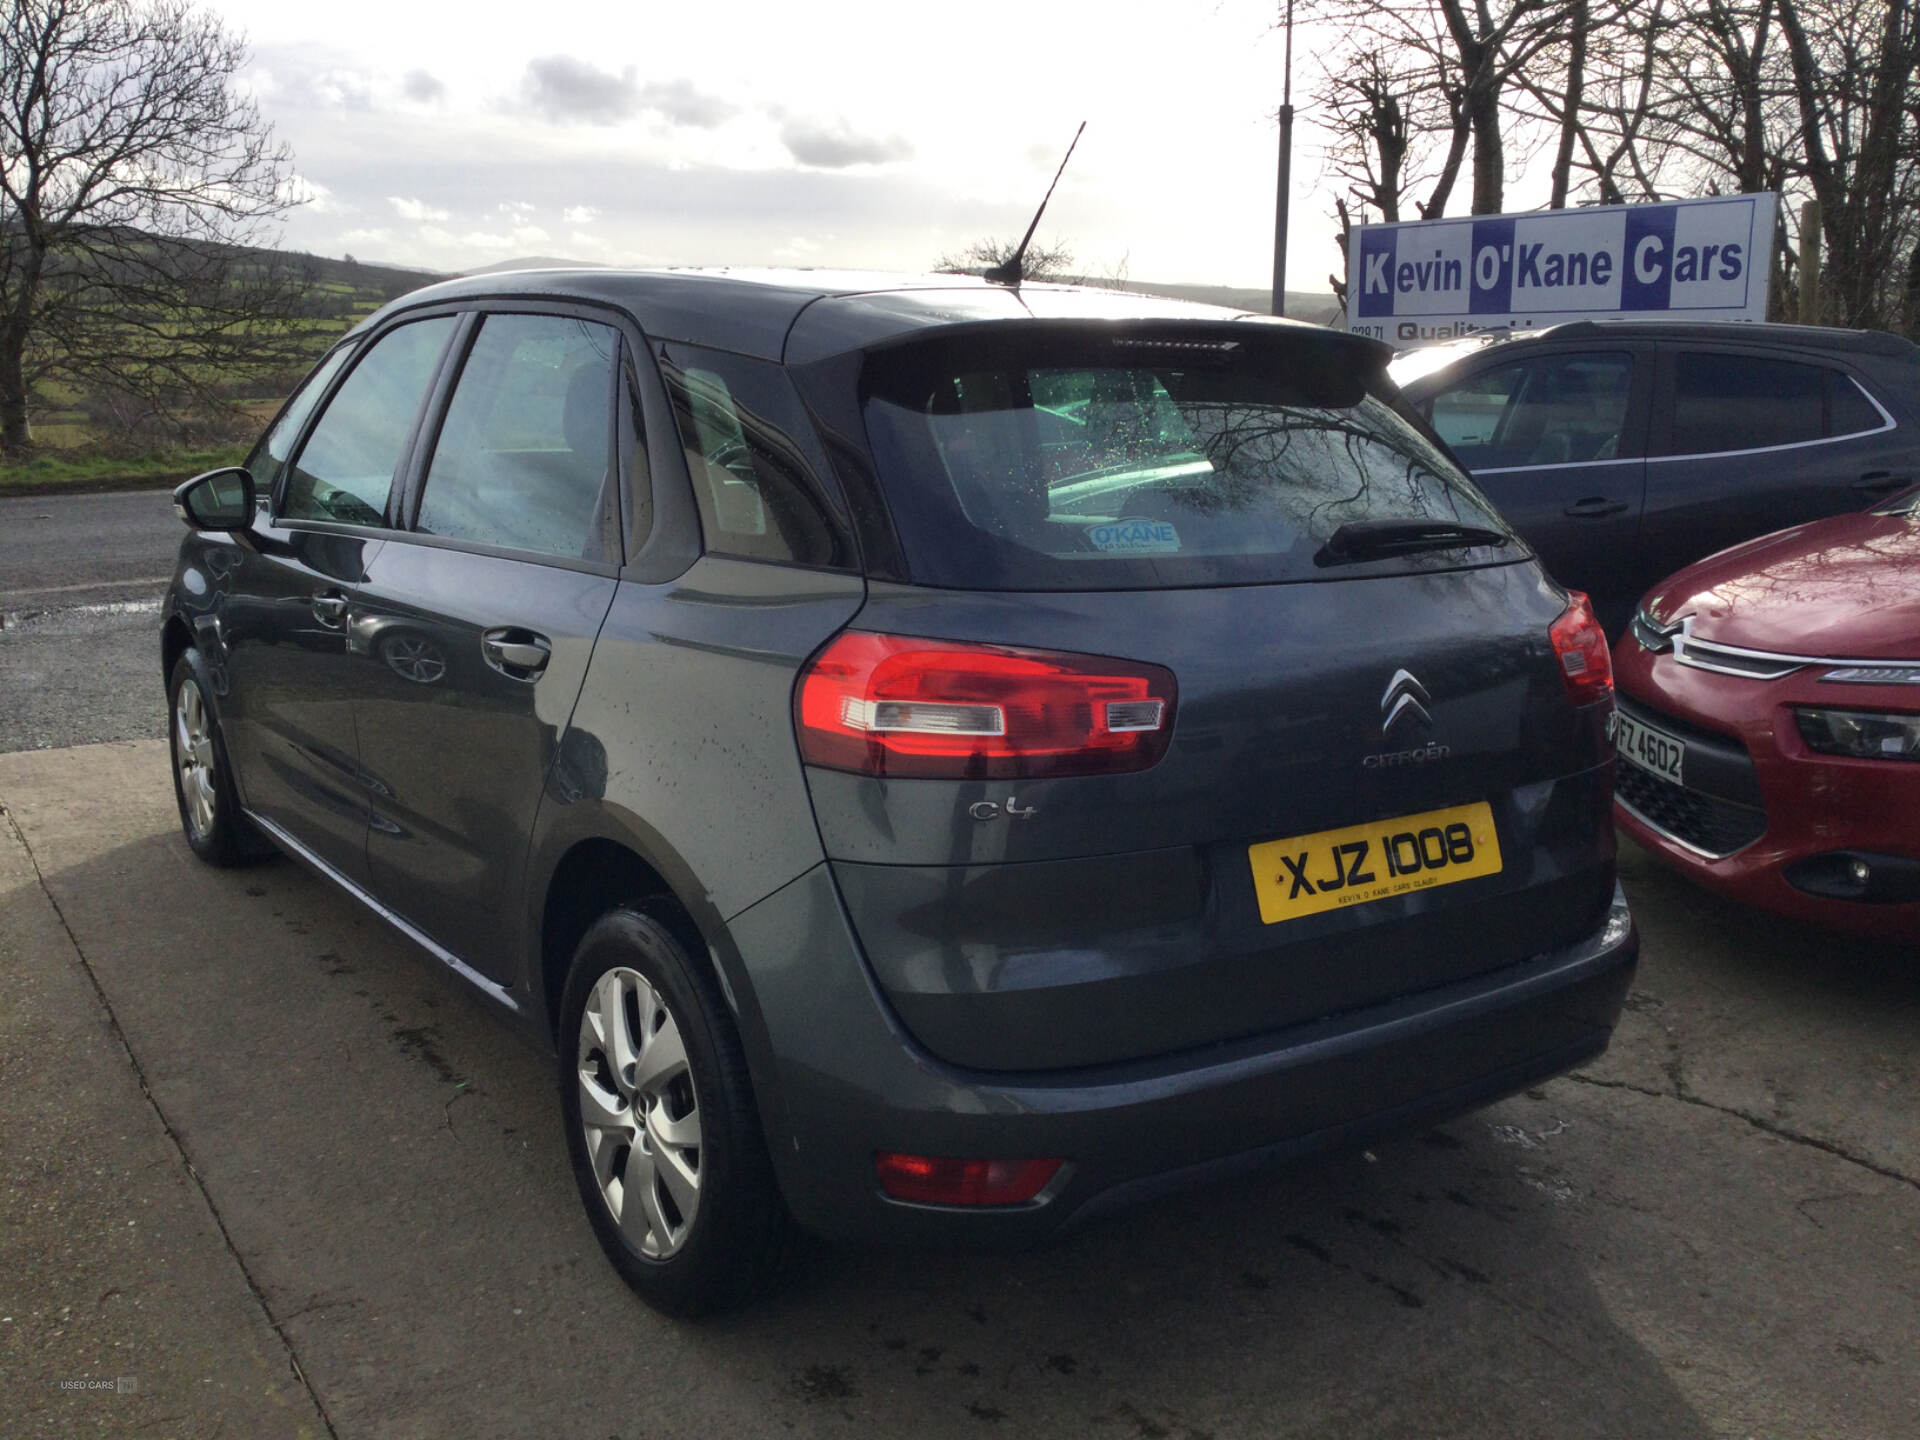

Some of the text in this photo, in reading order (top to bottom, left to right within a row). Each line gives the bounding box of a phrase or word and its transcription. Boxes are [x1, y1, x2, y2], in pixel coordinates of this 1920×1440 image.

[1365, 235, 1742, 295] Kevin O'Kane Cars
[1397, 321, 1487, 341] Qualit
[1638, 730, 1680, 778] 4602
[1280, 822, 1475, 900] XJZ 1008
